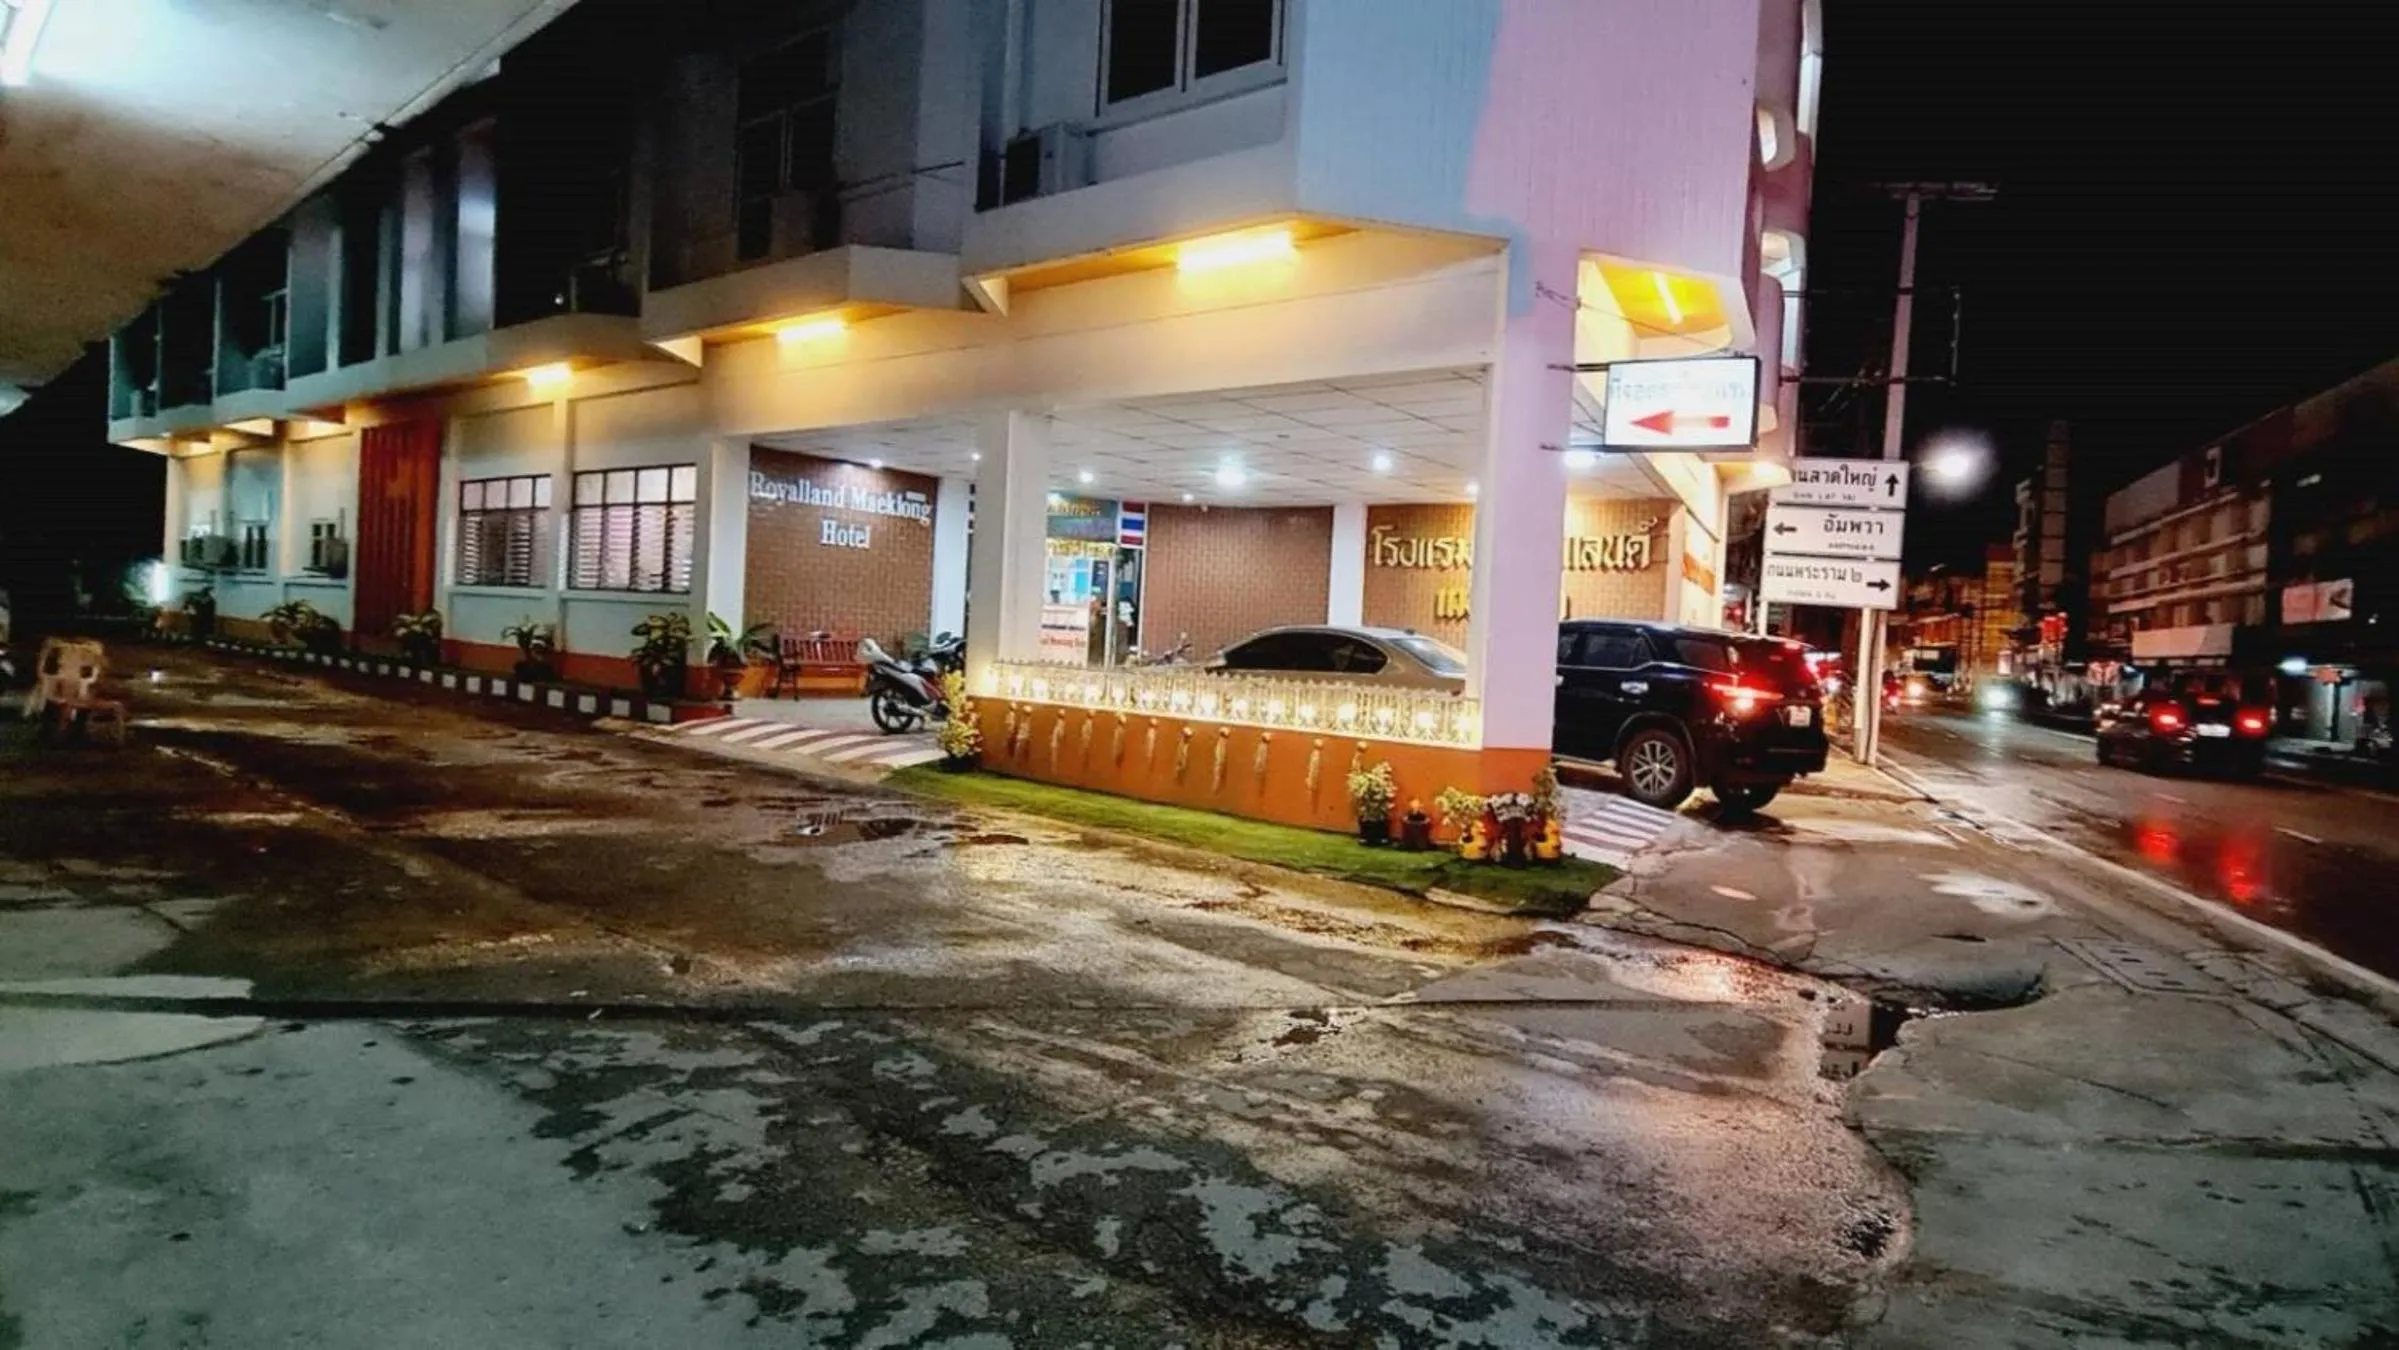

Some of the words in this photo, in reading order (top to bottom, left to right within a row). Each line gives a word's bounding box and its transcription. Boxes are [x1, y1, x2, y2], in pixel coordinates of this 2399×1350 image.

[750, 471, 845, 507] Royalland
[851, 485, 933, 525] Maeklong
[821, 517, 871, 549] Hotel
[1823, 513, 1884, 535] อัมพวา
